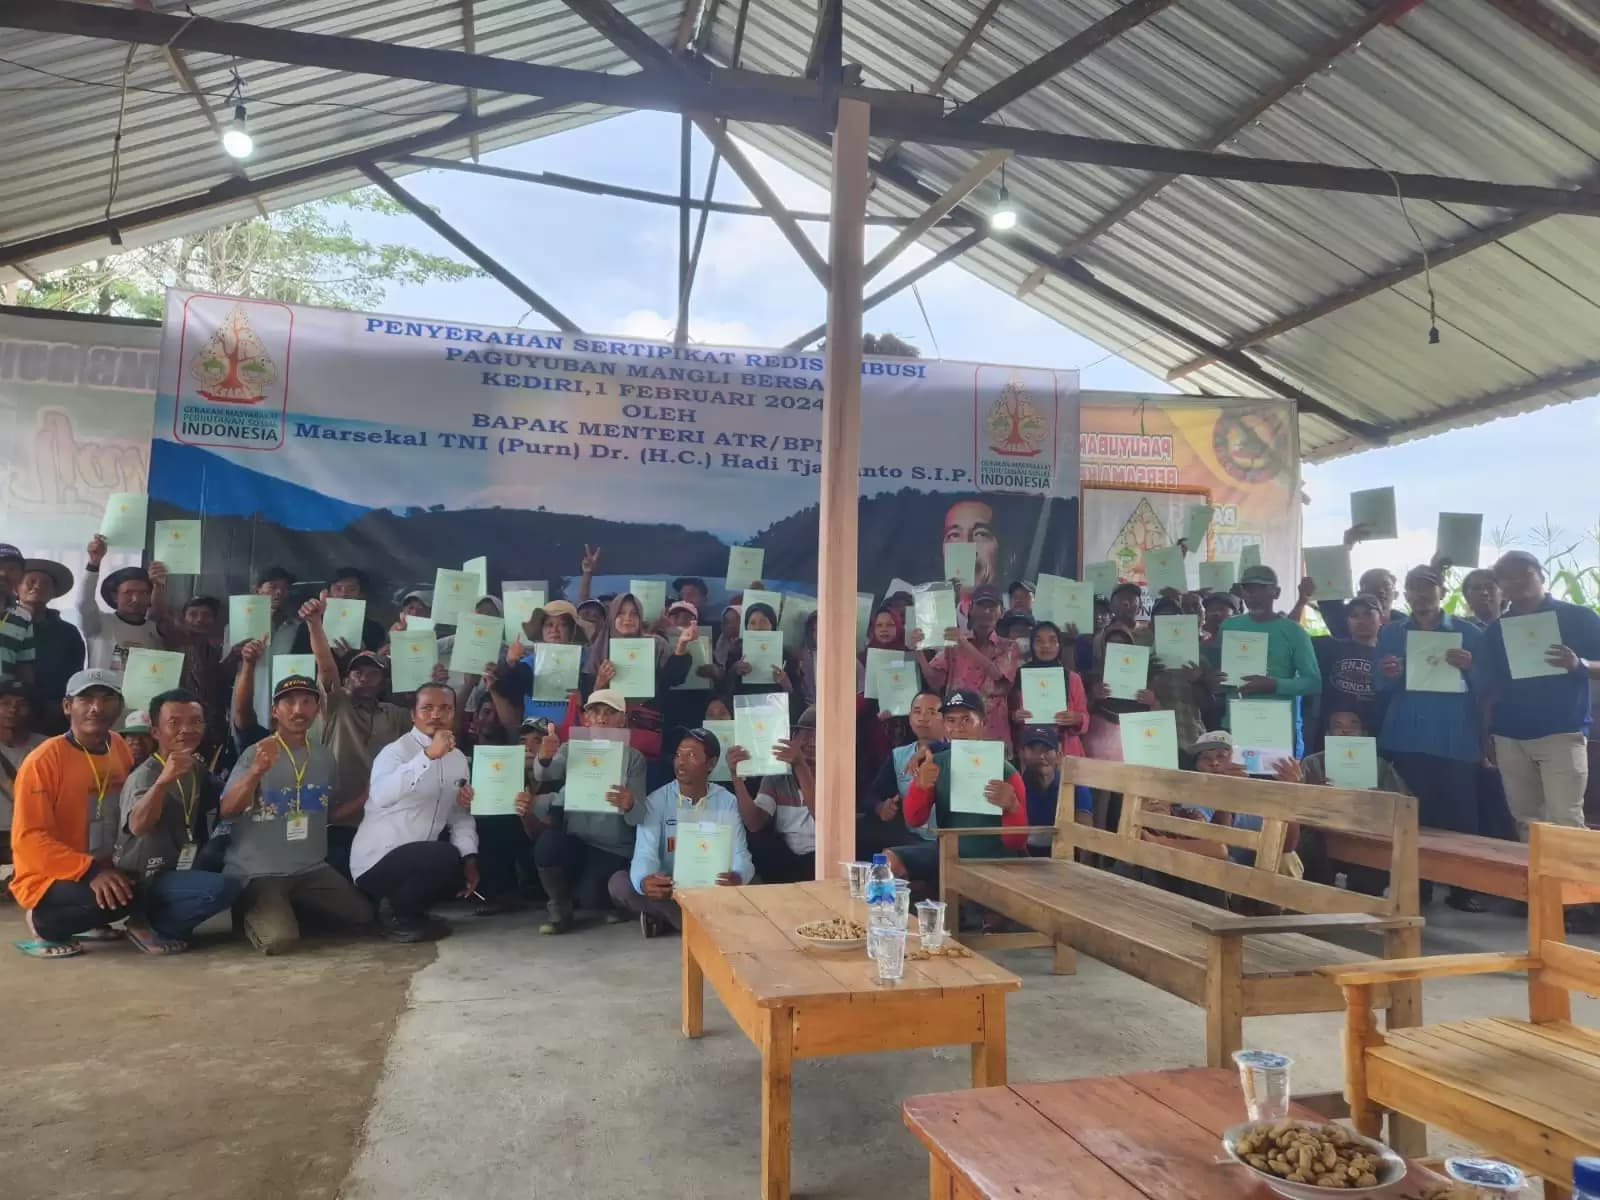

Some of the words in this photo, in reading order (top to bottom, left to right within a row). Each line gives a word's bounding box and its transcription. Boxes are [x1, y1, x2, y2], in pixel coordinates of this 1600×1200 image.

[366, 318, 563, 350] PENYERAHAN
[574, 339, 736, 366] SERTIPIKAT
[744, 353, 927, 379] REDISIBUSI
[445, 346, 616, 376] PAGUYUBAN
[626, 363, 730, 385] MANGLI
[740, 372, 824, 391] BERSA
[620, 383, 755, 407] FEBRUARI
[765, 394, 824, 411] 2024
[472, 412, 569, 435] BAPAK
[578, 421, 705, 444] MENTERI
[622, 404, 697, 423] OLEH
[182, 422, 278, 441] INDONESIA
[295, 422, 428, 447] Marsekal
[438, 431, 489, 450] TNI
[498, 436, 579, 461] (Purn)
[589, 443, 629, 461] Dr.
[640, 447, 712, 470] (H.C.)
[721, 453, 778, 472] Hadi
[911, 465, 973, 484] S.I.P.
[981, 473, 1051, 489] INDONESIA
